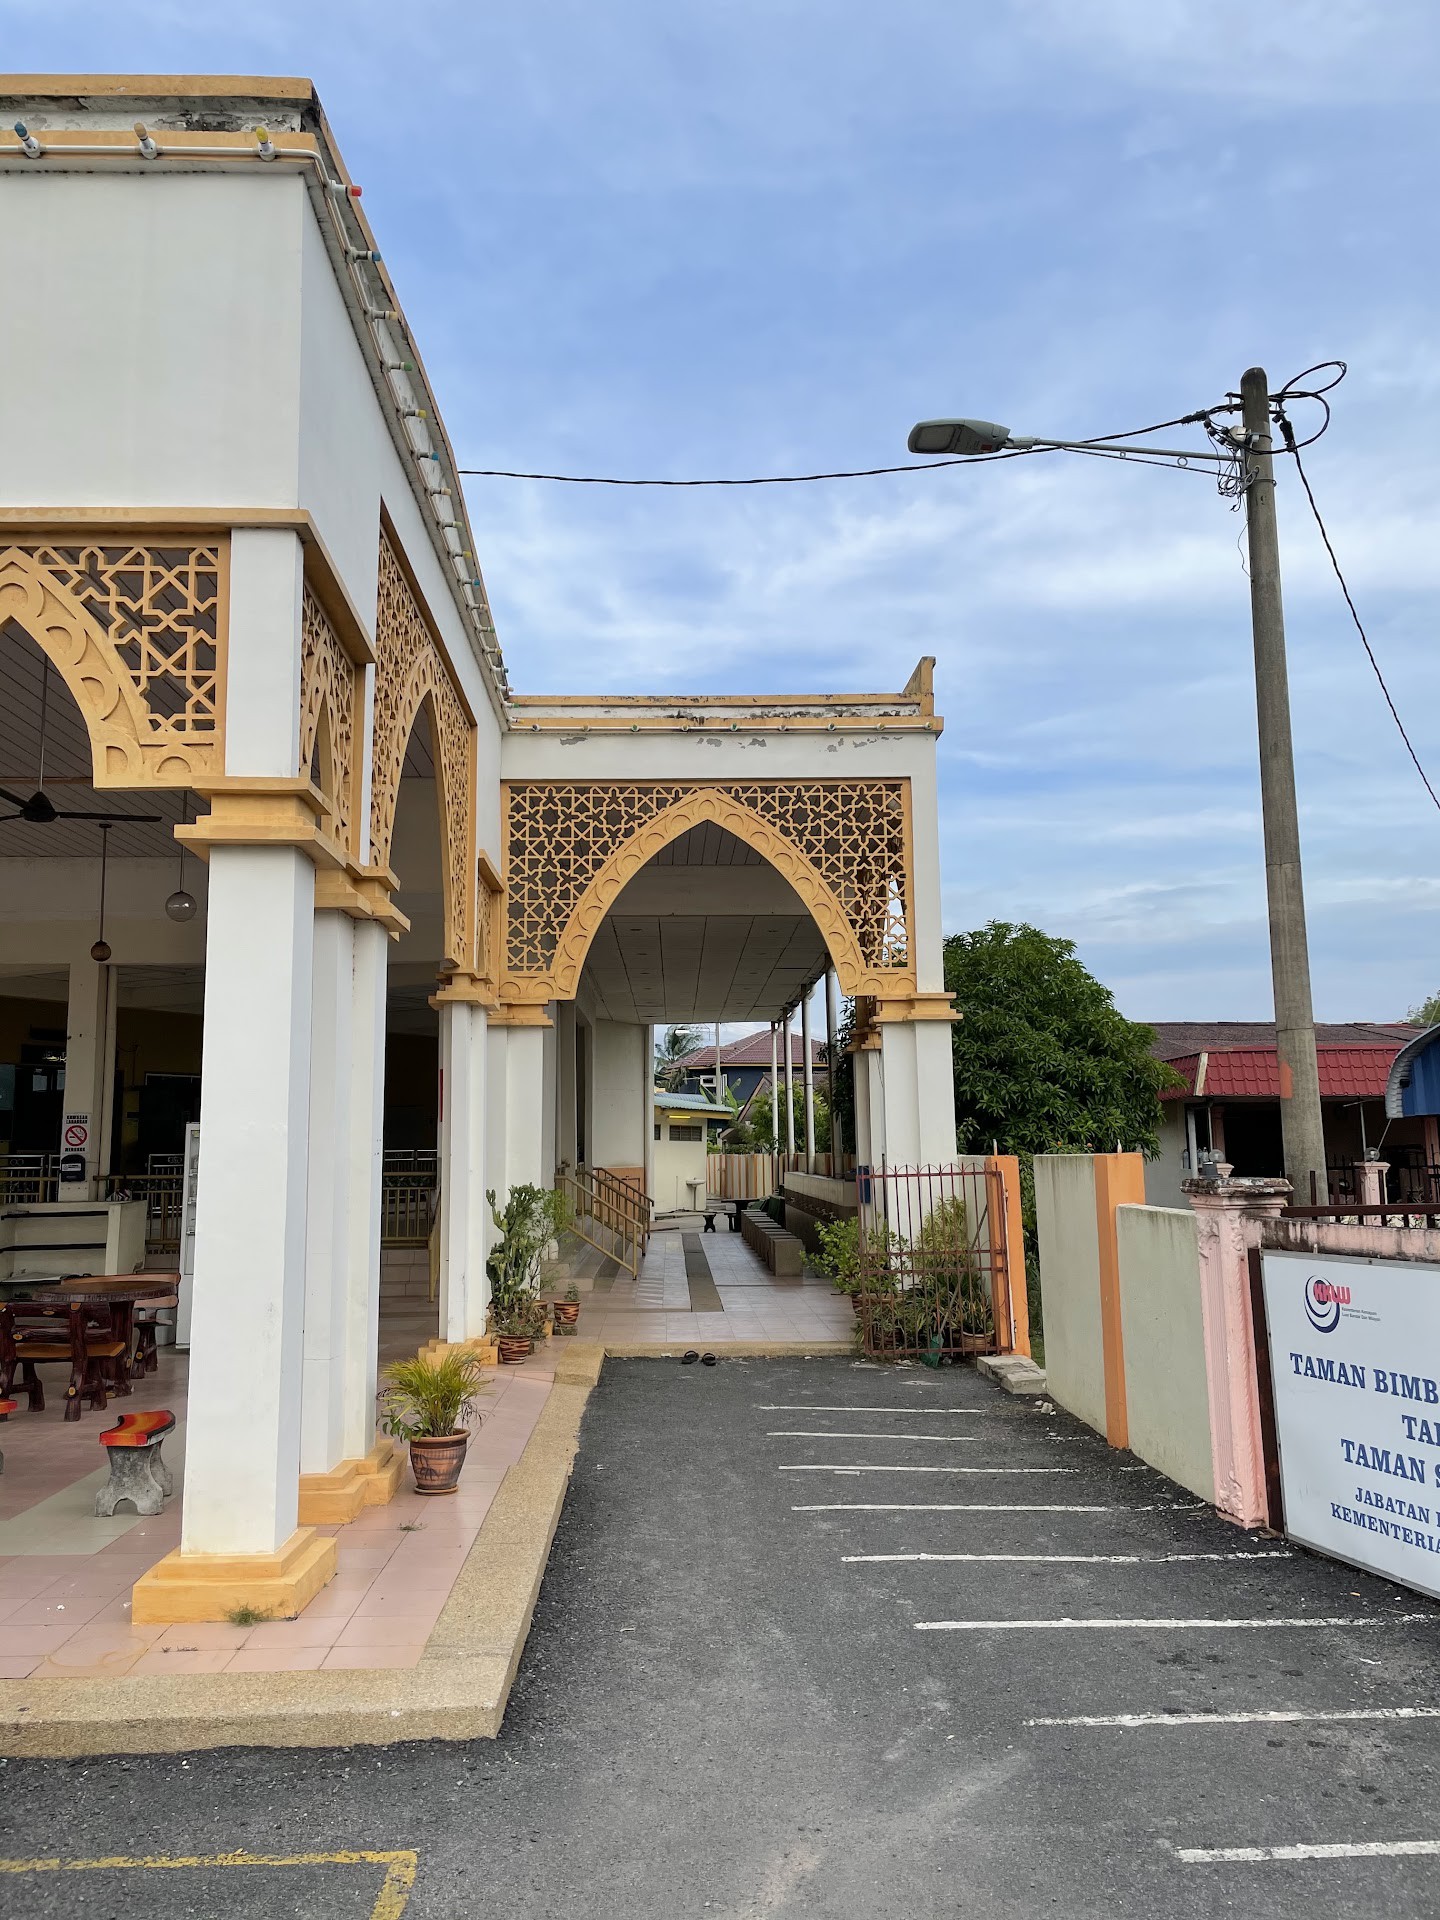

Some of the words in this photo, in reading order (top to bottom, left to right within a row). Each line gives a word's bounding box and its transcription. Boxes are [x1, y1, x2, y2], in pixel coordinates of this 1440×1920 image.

[1290, 1352, 1366, 1389] TAMAN
[1373, 1369, 1440, 1404] BIMB
[1341, 1439, 1425, 1483] TAMAN
[1355, 1487, 1429, 1524] JABATAN
